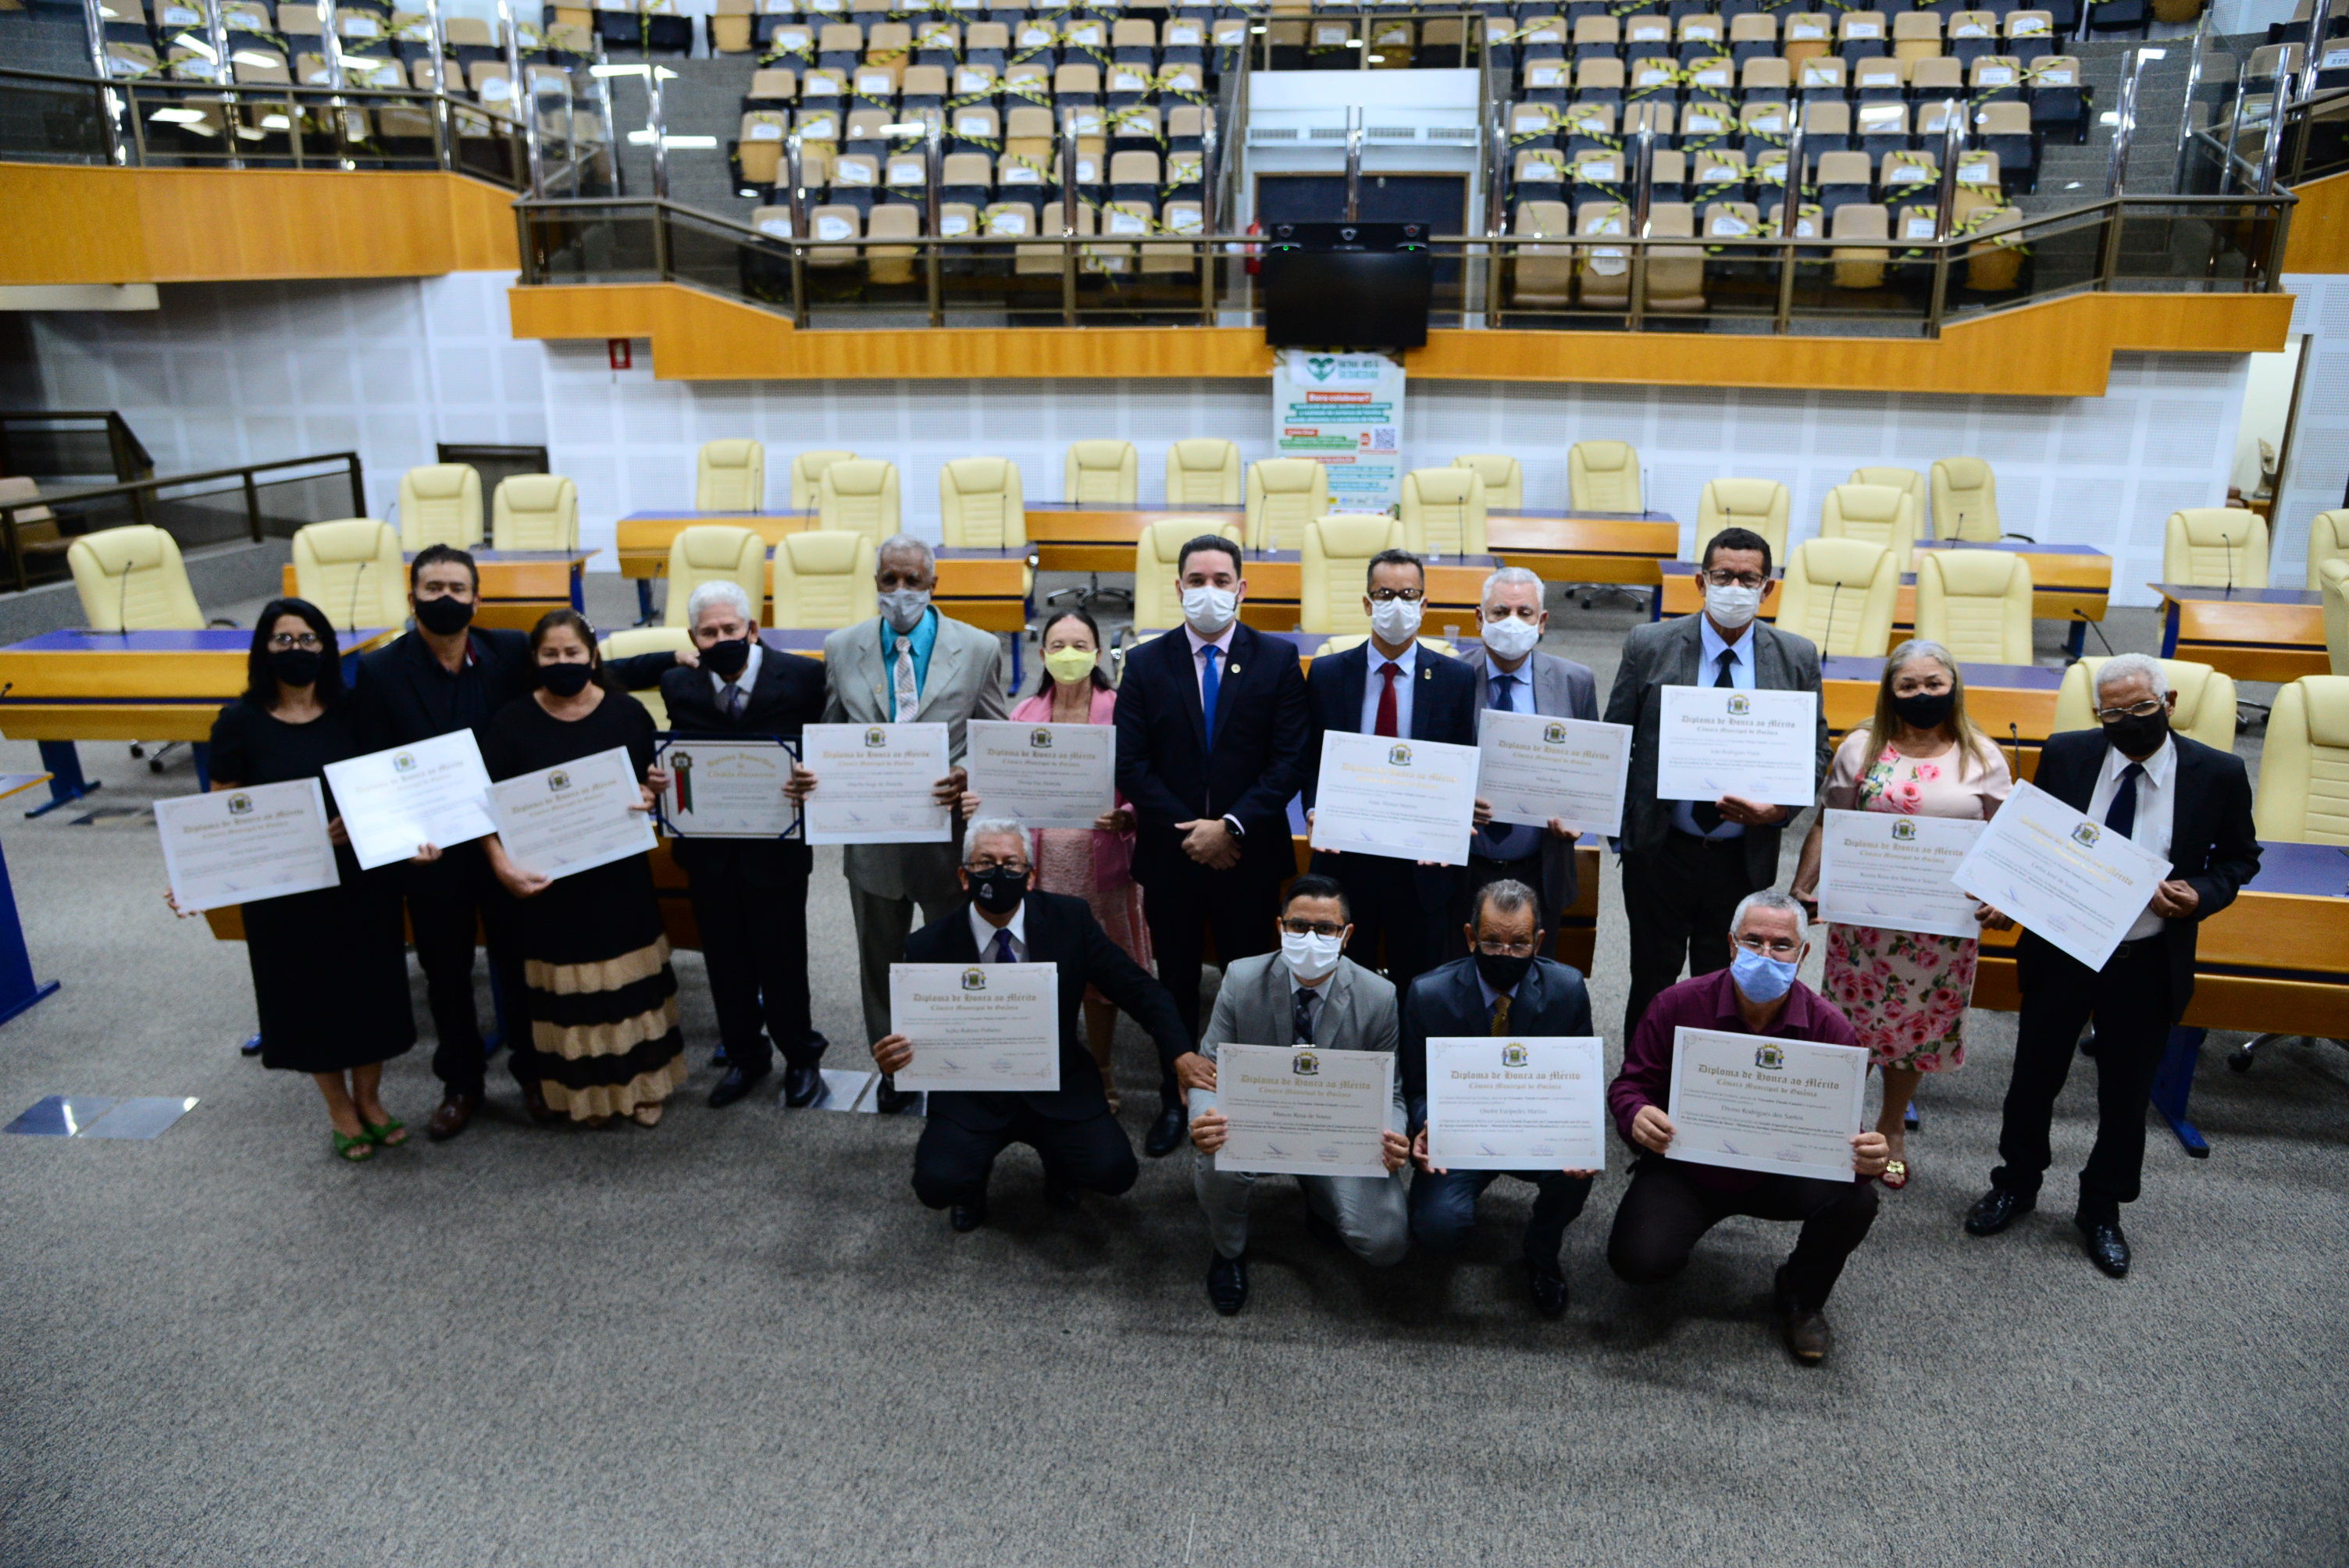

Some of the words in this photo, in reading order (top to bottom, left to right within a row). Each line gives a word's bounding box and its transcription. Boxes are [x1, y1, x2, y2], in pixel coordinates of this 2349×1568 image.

[1681, 715, 1715, 725] Diploma
[1728, 718, 1754, 726] Honra
[1767, 719, 1795, 729] Mérito
[1844, 838, 1879, 850] Diploma
[1893, 843, 1919, 853] Honra
[1934, 846, 1964, 857] Mérito
[913, 993, 950, 1002] Diploma
[1007, 993, 1036, 1002] Mérito
[1240, 1074, 1279, 1085] Diploma
[1294, 1078, 1323, 1087] Honra
[1338, 1080, 1371, 1090] Mérito
[1451, 1071, 1488, 1079] Diploma
[1549, 1071, 1581, 1080] Mérito
[1698, 1064, 1739, 1077] Diploma
[1756, 1071, 1788, 1083] Honra
[1805, 1077, 1841, 1090] Mérito
[1717, 1078, 1743, 1087] Câmara
[1745, 1082, 1778, 1092] Municipal
[1790, 1087, 1817, 1096] Goiânia
